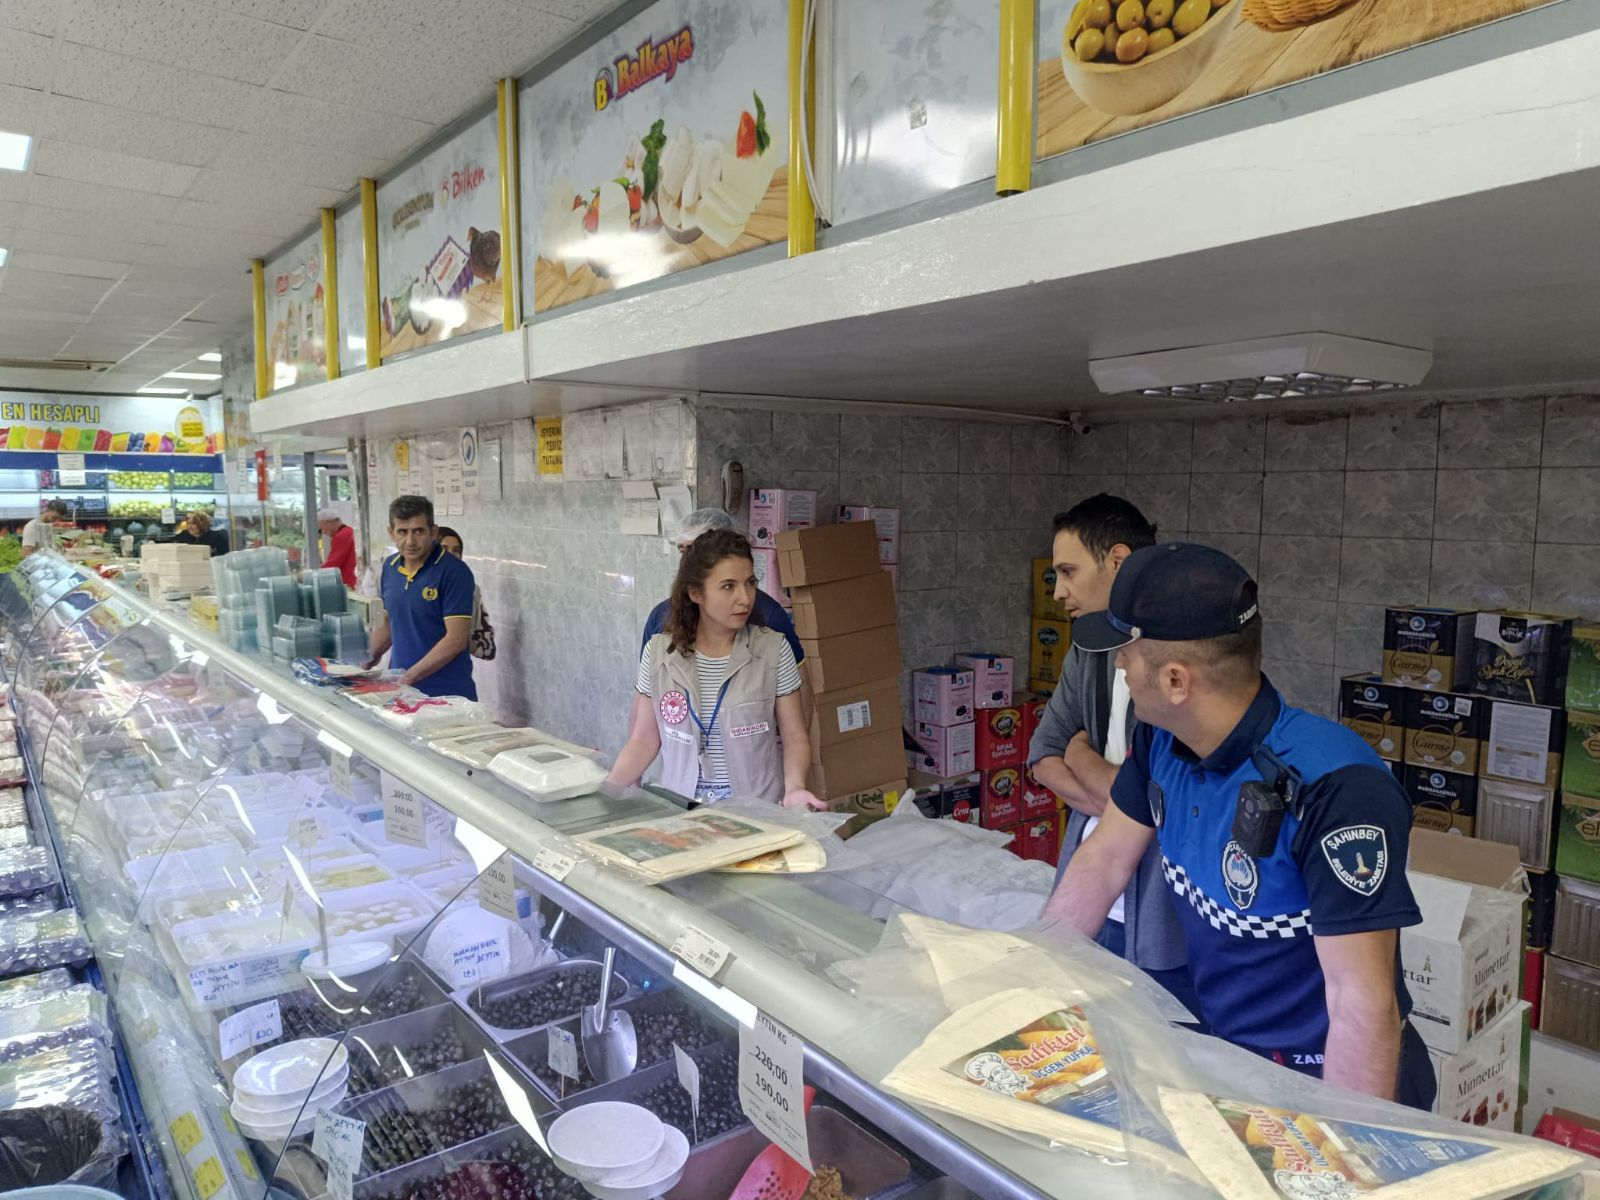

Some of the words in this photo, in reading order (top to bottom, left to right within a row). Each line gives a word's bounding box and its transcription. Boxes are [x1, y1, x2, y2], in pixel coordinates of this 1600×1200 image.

[613, 24, 694, 101] Balkaya
[451, 167, 485, 198] Bilken
[1, 402, 25, 421] EN
[30, 402, 100, 423] HESAPLI
[1391, 658, 1428, 674] Gurme
[1413, 735, 1451, 752] Gurme
[777, 1029, 788, 1045] KG
[755, 1046, 788, 1086] 220,00
[1062, 1046, 1095, 1066] YUFKA
[755, 1072, 789, 1112] 190,00
[1457, 1060, 1506, 1099] Minnettar
